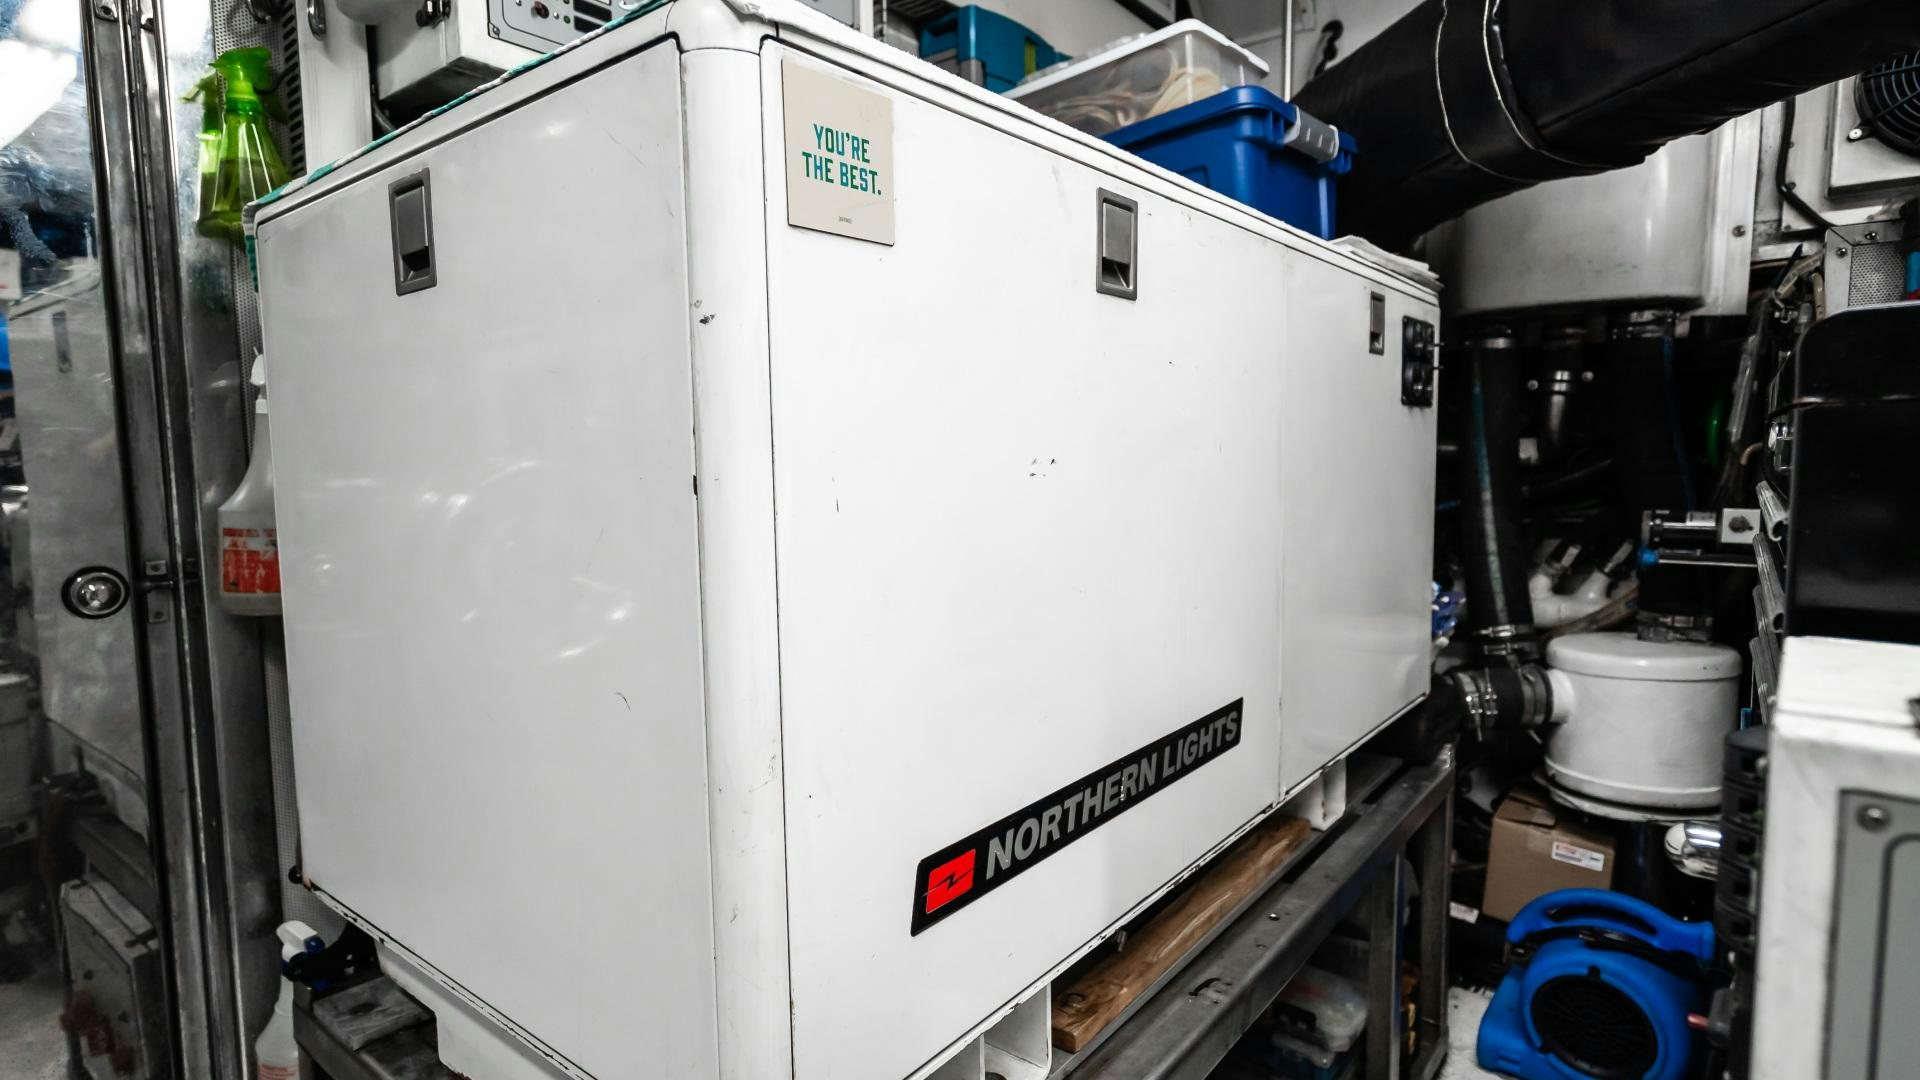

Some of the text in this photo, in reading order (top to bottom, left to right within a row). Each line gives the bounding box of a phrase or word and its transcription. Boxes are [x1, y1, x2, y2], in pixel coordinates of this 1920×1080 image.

[813, 123, 870, 162] YOU'RE
[802, 152, 882, 195] THE BEST.
[986, 711, 1238, 879] NORTHERN LIGHTS
